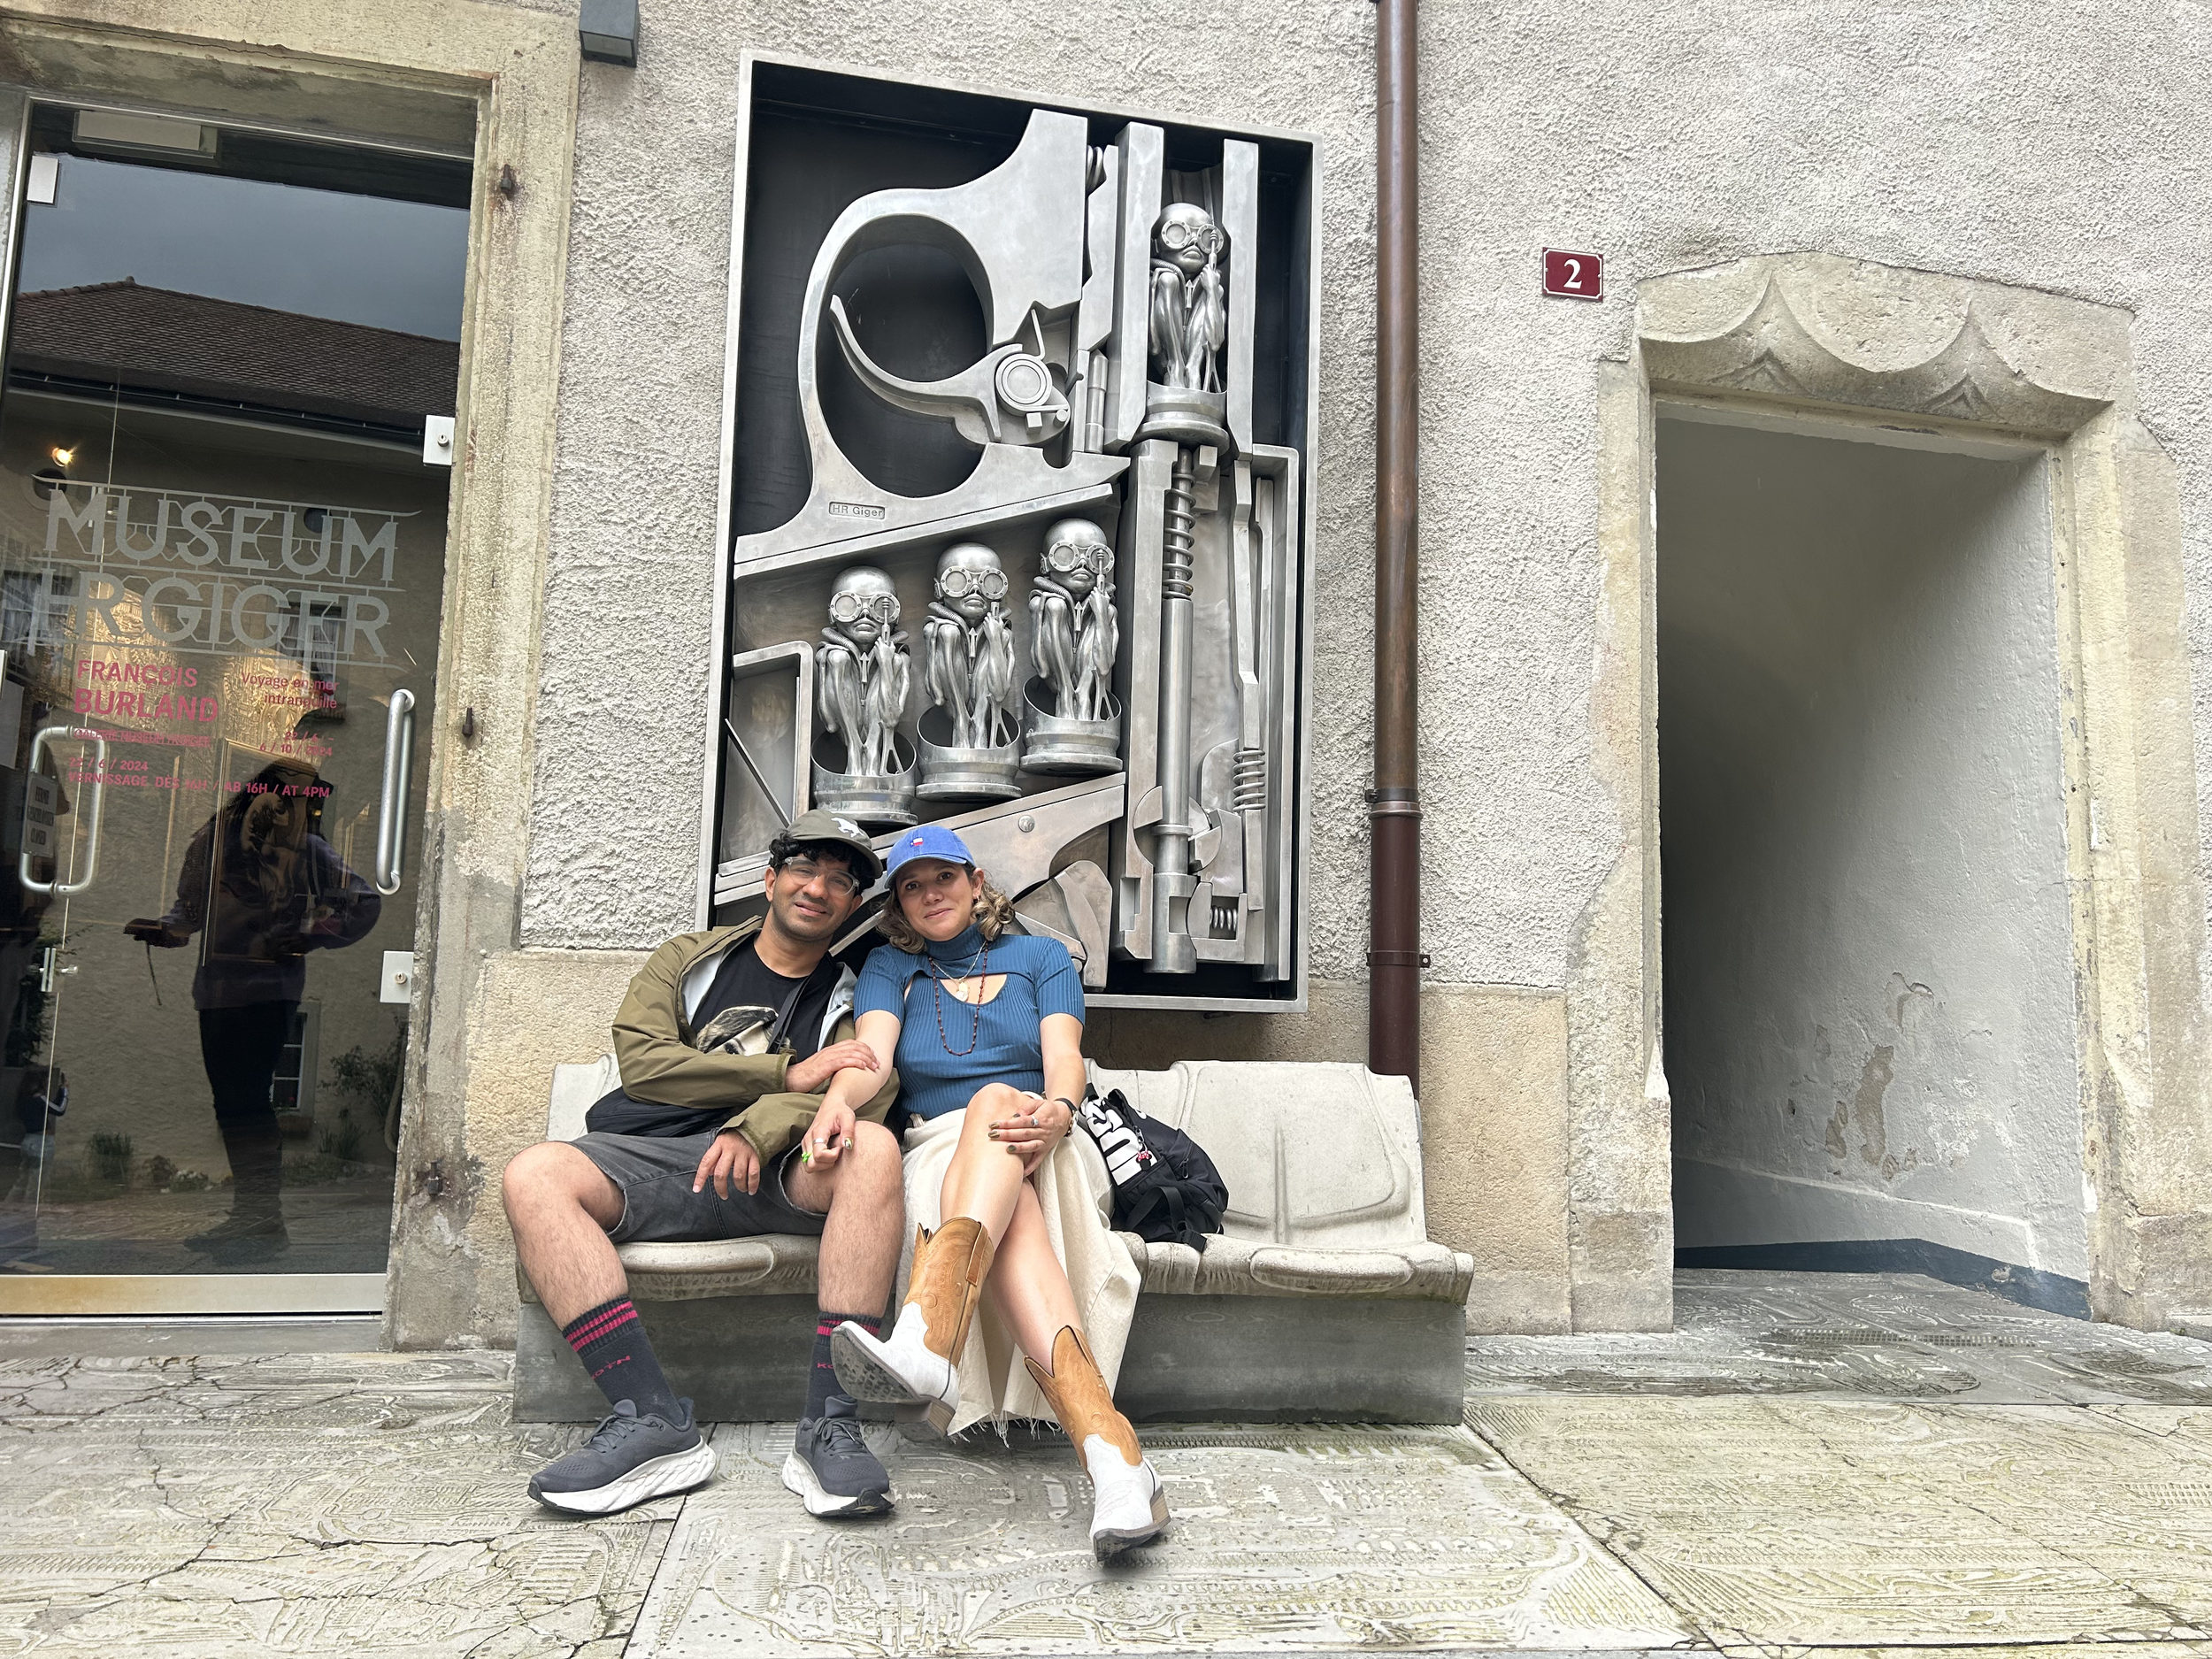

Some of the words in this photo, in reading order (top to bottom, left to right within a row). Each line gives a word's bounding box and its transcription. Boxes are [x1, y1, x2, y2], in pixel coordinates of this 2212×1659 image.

[1563, 258, 1582, 289] 2
[832, 504, 849, 514] HR
[852, 506, 883, 518] Giger
[43, 489, 399, 581] MUSEUM
[77, 659, 198, 689] FRANÇOIS
[242, 672, 288, 689] Voyage
[293, 678, 309, 688] en
[314, 680, 340, 691] mer
[73, 687, 219, 722] BURLAND
[265, 693, 337, 709] intranquille
[285, 731, 298, 741] 22
[280, 744, 293, 754] 10
[305, 745, 333, 757] 2024
[69, 757, 84, 768] 22
[98, 758, 106, 769] 6
[119, 760, 149, 772] 2024
[68, 771, 149, 787] VERNISSAGE
[155, 774, 180, 789] DÈS
[184, 779, 207, 791] 16H
[223, 781, 242, 793] AB
[246, 782, 268, 795] 16H
[281, 785, 299, 797] AT
[302, 786, 330, 799] 4PM
